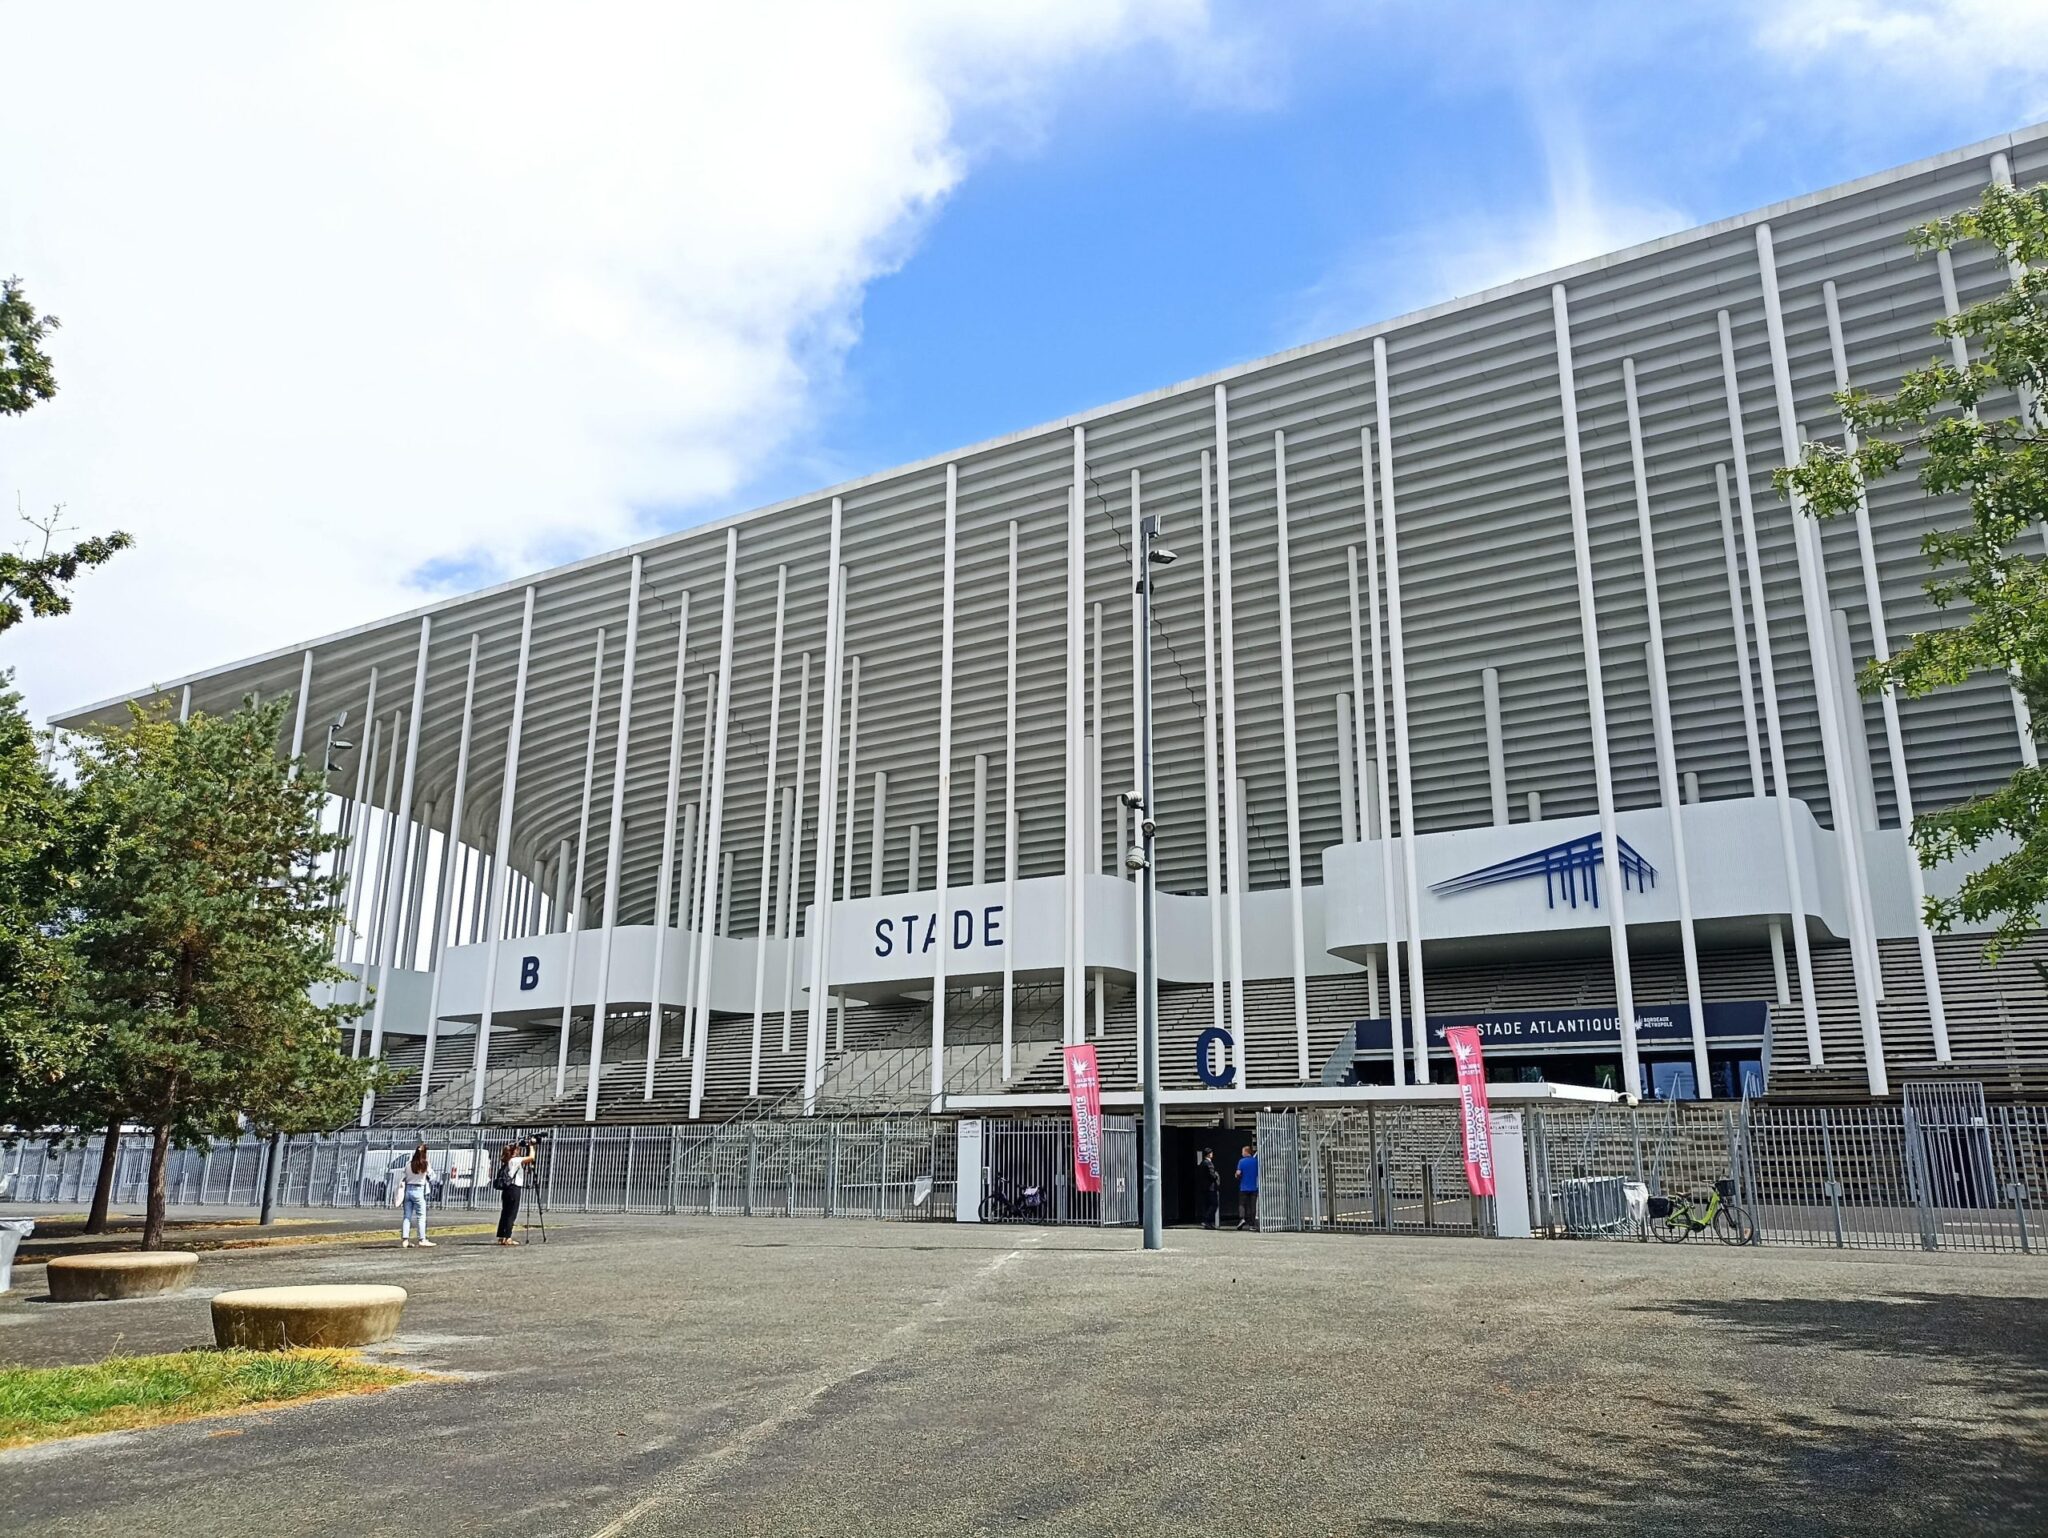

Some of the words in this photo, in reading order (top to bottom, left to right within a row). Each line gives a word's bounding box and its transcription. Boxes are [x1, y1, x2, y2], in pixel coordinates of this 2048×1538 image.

[875, 905, 1004, 957] STADE
[520, 956, 540, 991] B
[1477, 1022, 1523, 1037] STADE
[1529, 1017, 1621, 1034] ATLANTIQUE
[1196, 1027, 1236, 1087] C
